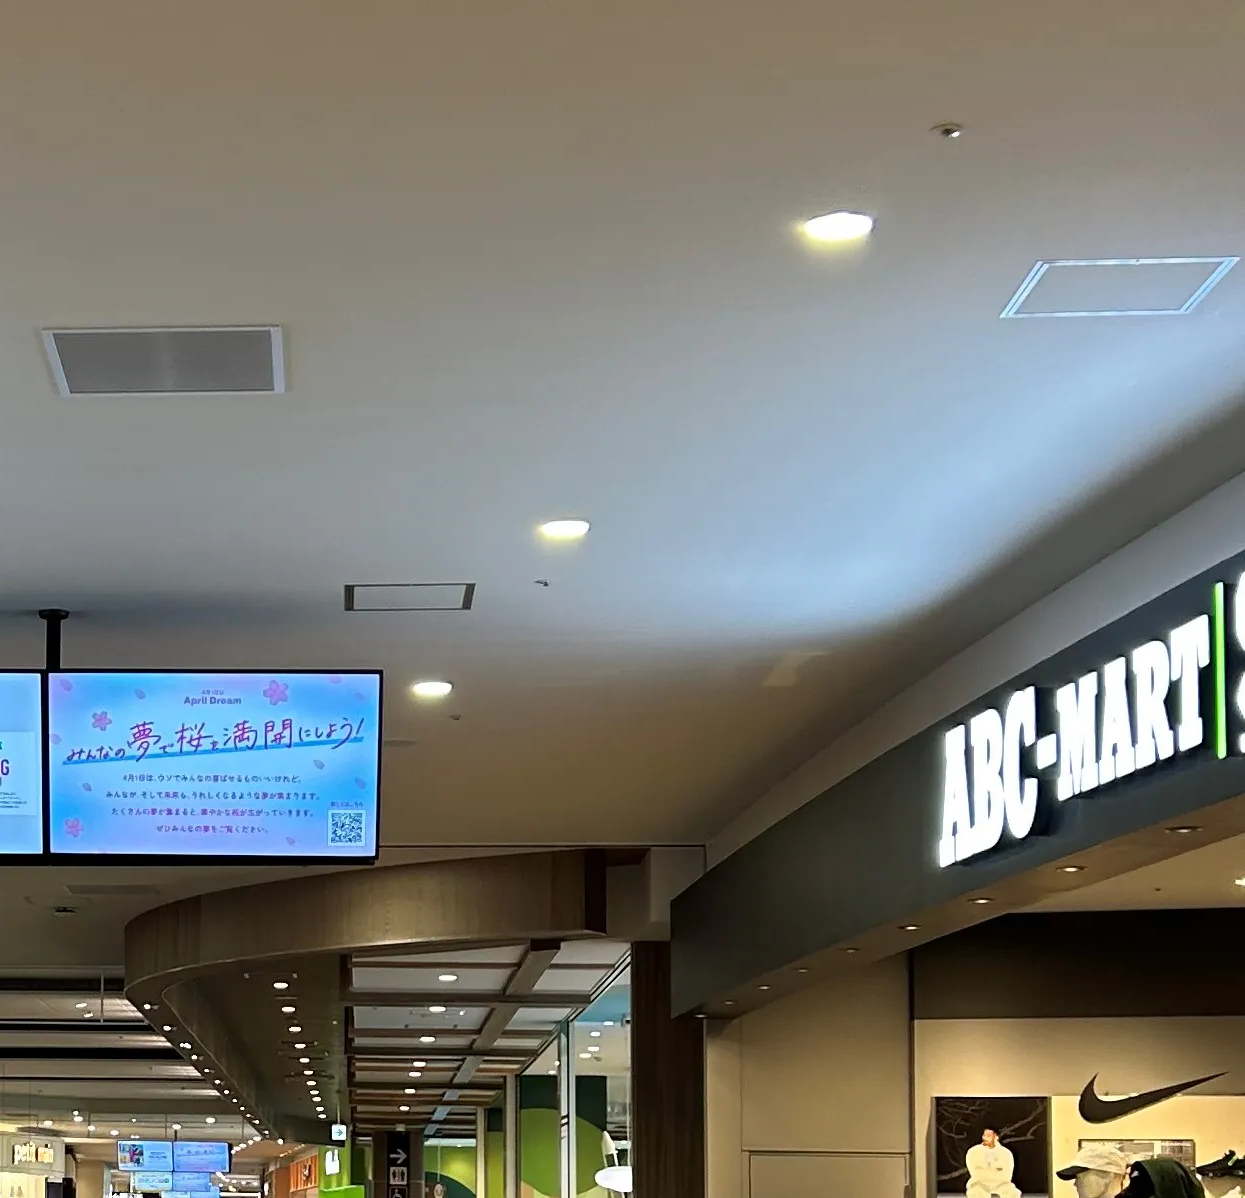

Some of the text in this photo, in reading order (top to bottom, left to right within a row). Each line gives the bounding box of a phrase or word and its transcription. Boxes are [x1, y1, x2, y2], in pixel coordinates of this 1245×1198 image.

[183, 696, 242, 706] April Dream
[938, 613, 1210, 868] ABC-MART
